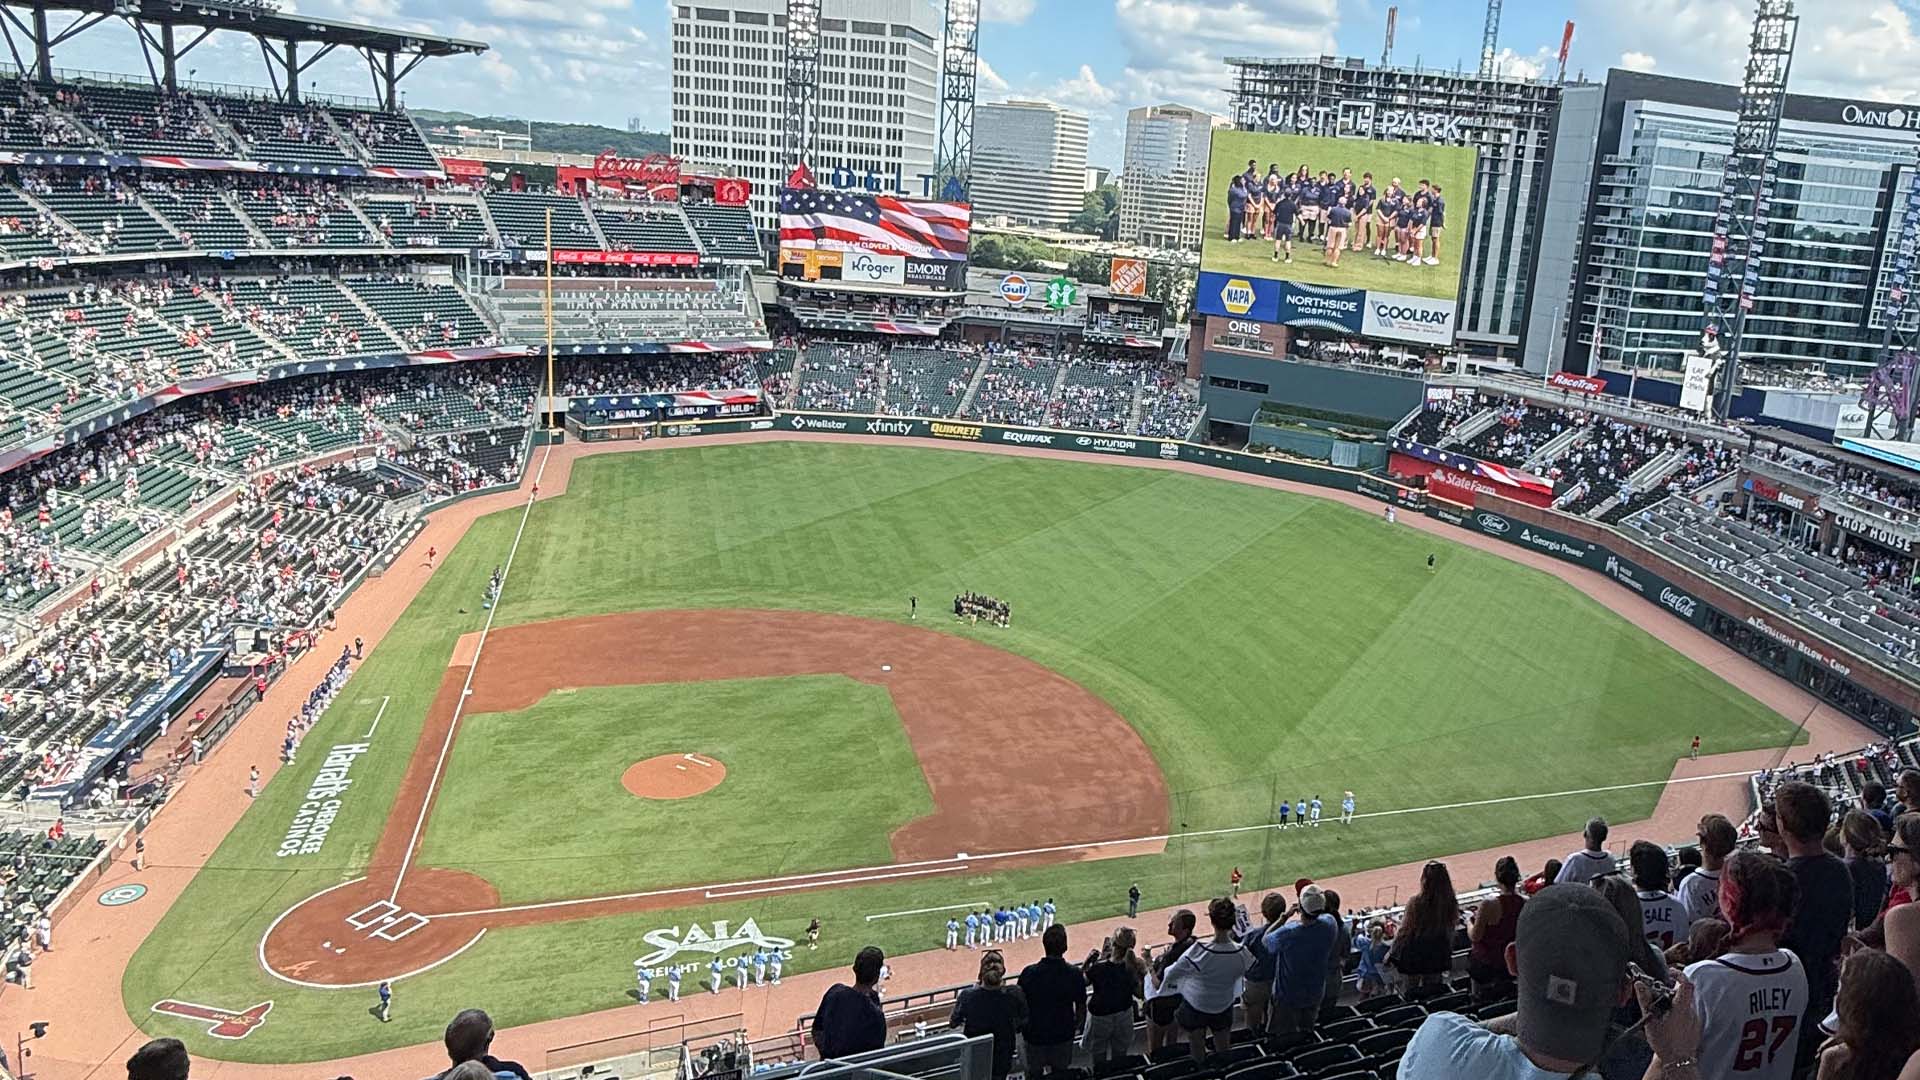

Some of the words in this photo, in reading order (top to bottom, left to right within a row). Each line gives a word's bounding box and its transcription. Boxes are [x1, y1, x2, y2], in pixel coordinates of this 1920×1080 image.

[1229, 102, 1331, 131] TRUIST
[1381, 111, 1462, 140] PARK
[1842, 104, 1888, 126] OMNI
[831, 164, 967, 200] DELTA
[852, 255, 896, 279] Kroger
[907, 262, 948, 276] EMORY
[1002, 283, 1028, 294] Gulf
[1226, 288, 1250, 306] NAPA
[1286, 294, 1358, 313] NORTHSIDE
[1297, 307, 1343, 319] HOSPITAL
[1376, 304, 1450, 325] COOLRAY
[1228, 321, 1261, 335] ORIS
[1553, 374, 1598, 392] RaceTrac
[806, 418, 848, 429] Wellstar
[866, 418, 912, 435] xfinity
[930, 422, 982, 437] QUIKRETE
[1002, 431, 1054, 444] EQUIFAX
[1093, 438, 1136, 449] HYUNDAI
[1777, 492, 1805, 510] LIGHT
[1482, 516, 1505, 530] Ford
[1834, 514, 1867, 534] CHOP
[1869, 527, 1912, 552] HOUSE
[1532, 534, 1561, 551] Georgia
[1561, 543, 1585, 558] Power
[1829, 658, 1851, 676] CHOP
[276, 801, 321, 856] CASINOS
[299, 799, 342, 854] CHEROKEE
[1645, 907, 1673, 924] SALE
[634, 916, 796, 967] SAIA
[1750, 987, 1792, 1015] RILEY
[1732, 1014, 1798, 1072] 27
